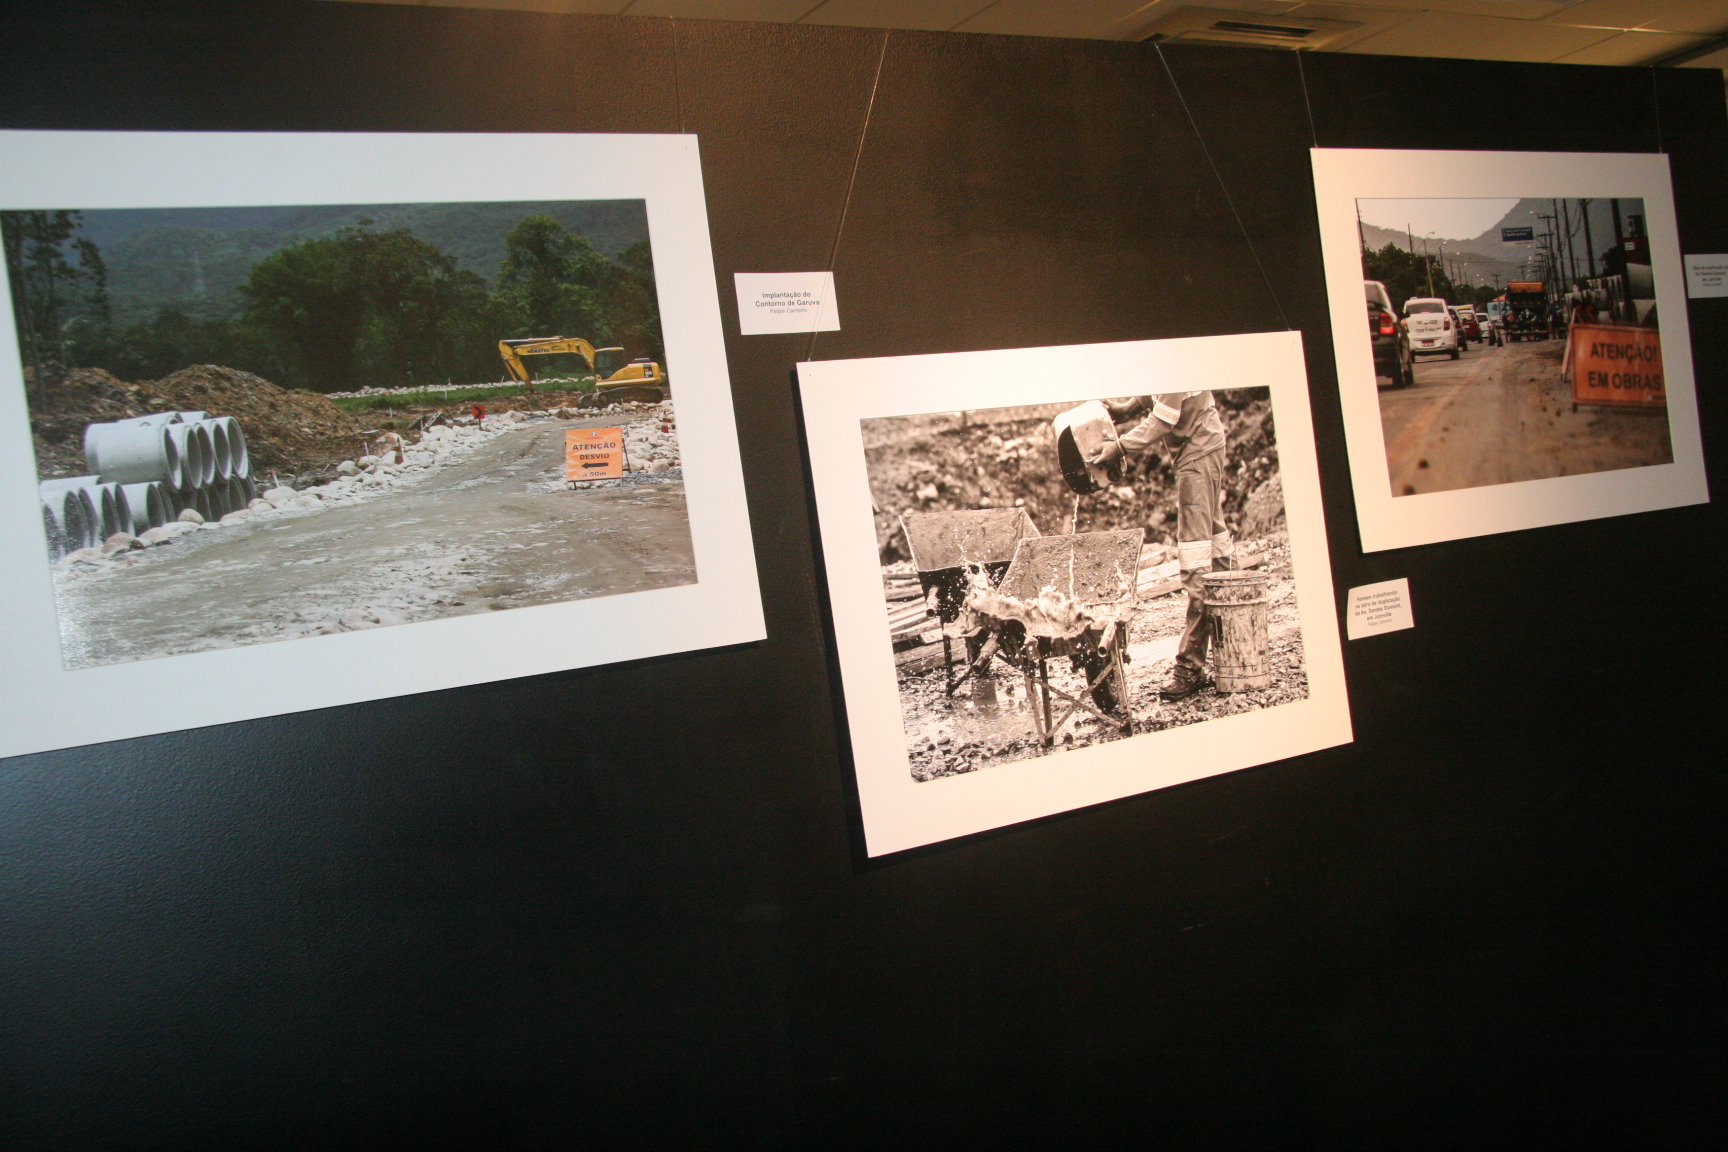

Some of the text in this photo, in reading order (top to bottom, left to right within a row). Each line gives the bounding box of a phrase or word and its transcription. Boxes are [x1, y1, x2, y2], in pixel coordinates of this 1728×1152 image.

[762, 291, 801, 299] Implantação
[1588, 371, 1662, 391] EM OBRAS
[573, 442, 616, 450] ATENÇÃO
